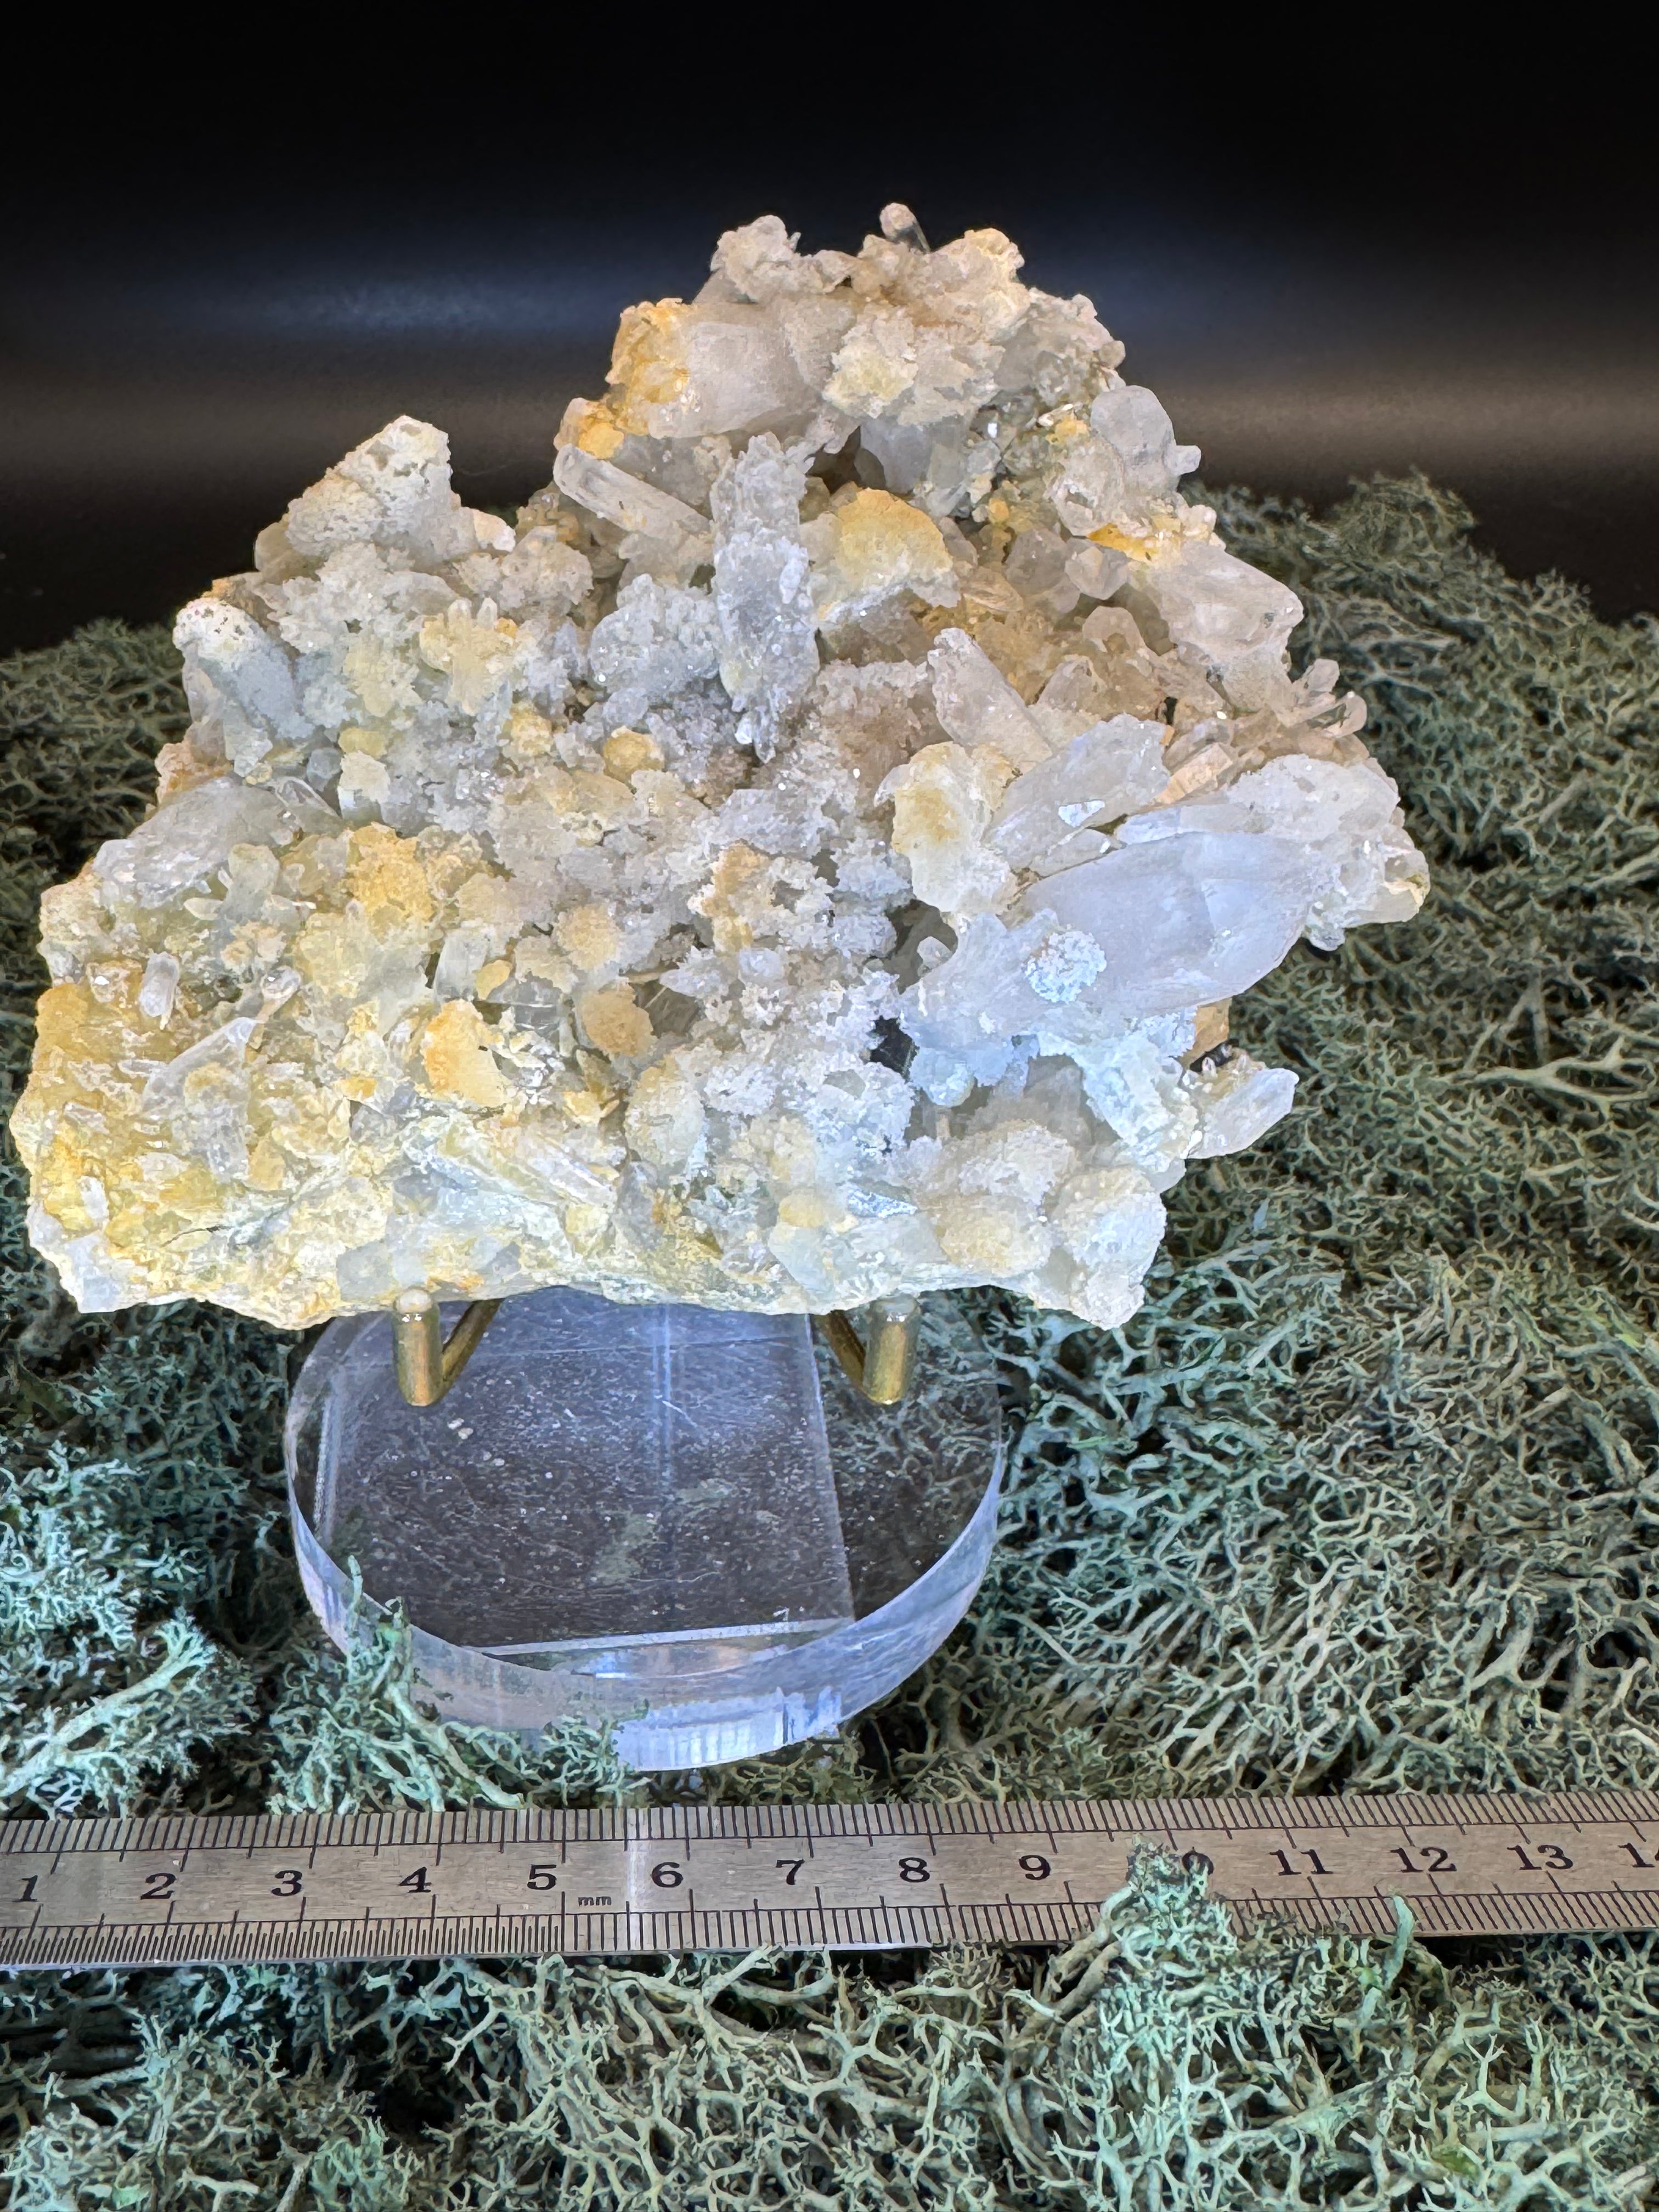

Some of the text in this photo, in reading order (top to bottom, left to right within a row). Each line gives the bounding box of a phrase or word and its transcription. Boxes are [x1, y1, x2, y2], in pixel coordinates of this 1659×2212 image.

[13, 1875, 38, 1902] 1
[140, 1873, 176, 1899] 2
[271, 1870, 302, 1897] 3
[399, 1866, 432, 1893] 4
[527, 1865, 557, 1890] 5
[651, 1862, 684, 1888] 6
[776, 1858, 805, 1885] 7
[899, 1857, 930, 1883] 8
[1019, 1855, 1051, 1880] 9
[1269, 1849, 1334, 1875] 11
[1391, 1847, 1457, 1873] 12
[1507, 1844, 1573, 1870] 13
[1618, 1843, 1659, 1867] 1
[578, 1896, 612, 1906] mm
